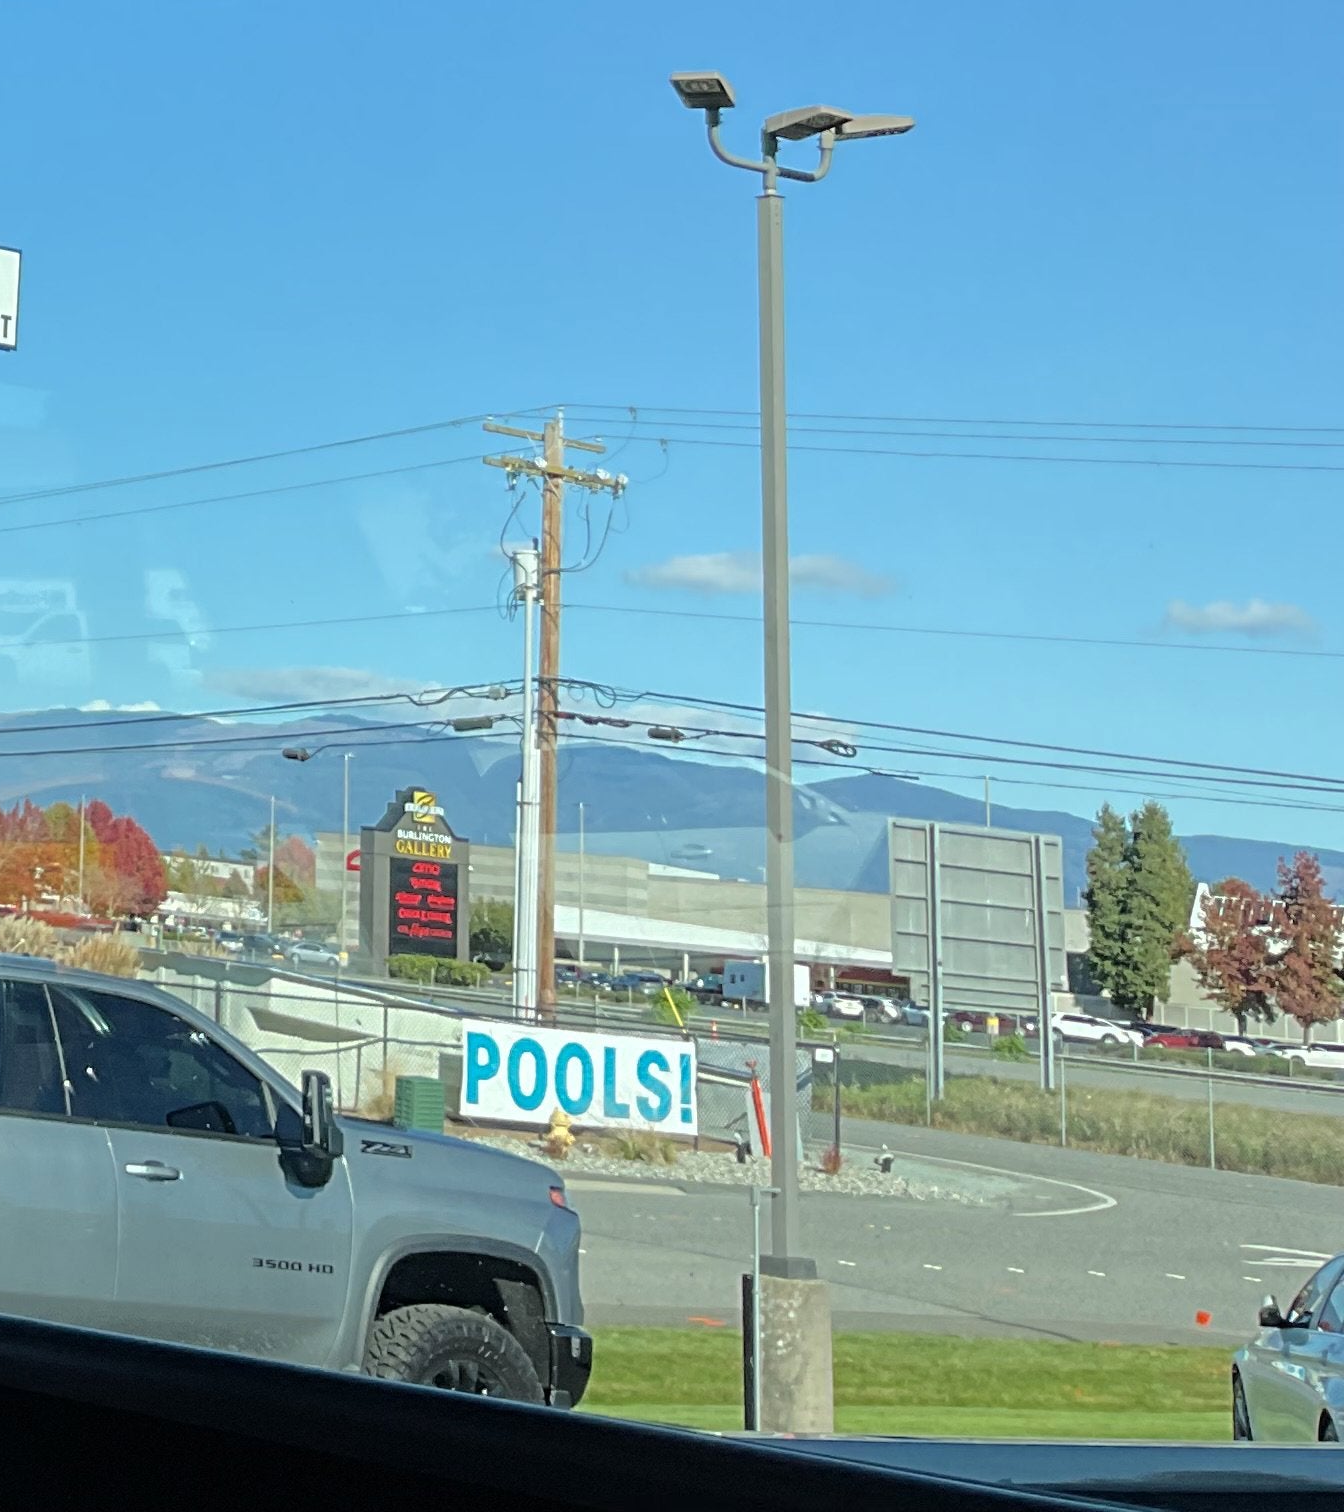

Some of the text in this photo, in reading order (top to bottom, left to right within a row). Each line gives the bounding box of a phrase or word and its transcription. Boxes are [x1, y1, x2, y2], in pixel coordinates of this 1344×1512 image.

[397, 829, 452, 844] BURLINGTON
[396, 839, 451, 859] GALLERY
[466, 1031, 694, 1124] POOLS!
[252, 1257, 334, 1274] 3500 HD
